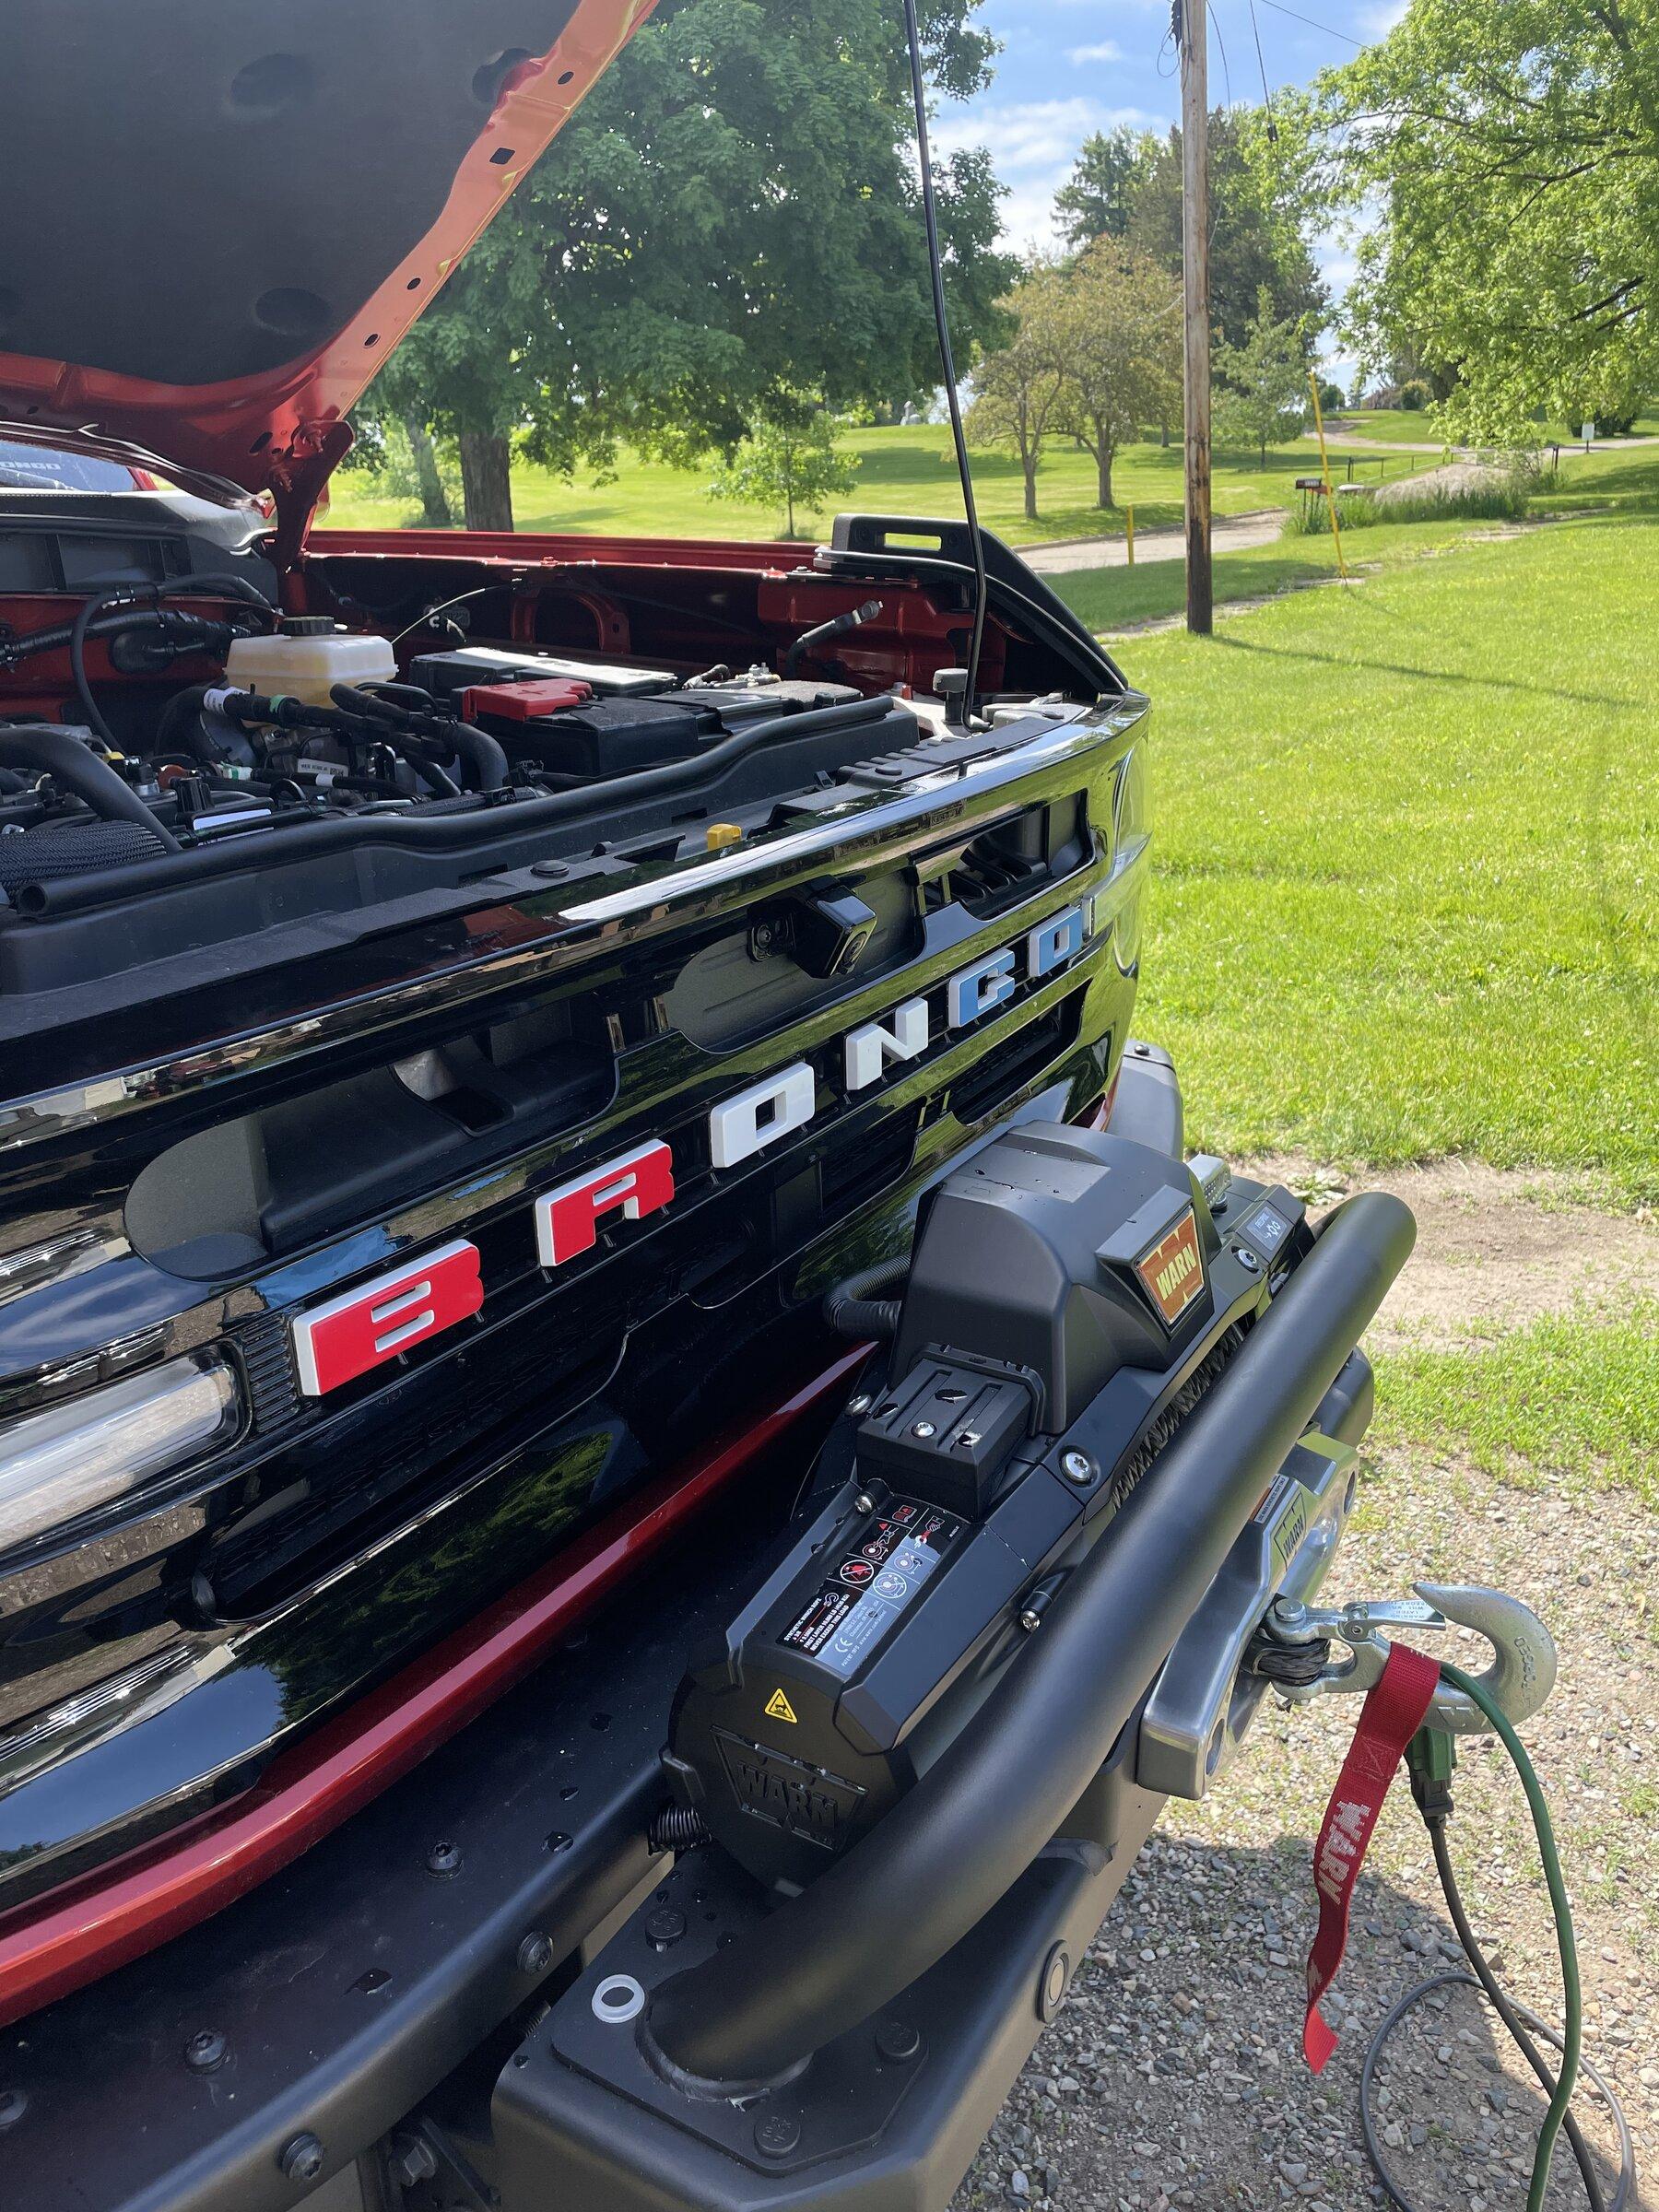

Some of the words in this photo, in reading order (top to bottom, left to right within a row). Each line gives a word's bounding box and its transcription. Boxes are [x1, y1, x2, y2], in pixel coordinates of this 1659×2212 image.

[290, 905, 1084, 1396] BRONCO
[1155, 1242, 1197, 1301] WARN
[1283, 1514, 1304, 1559] WARN
[809, 1637, 823, 1651] NEVER
[819, 1622, 834, 1638] EXCEED
[830, 1614, 841, 1624] THIS
[838, 1604, 850, 1616] LOAD
[736, 1759, 839, 1832] WARN
[1318, 1800, 1371, 1905] WARN
